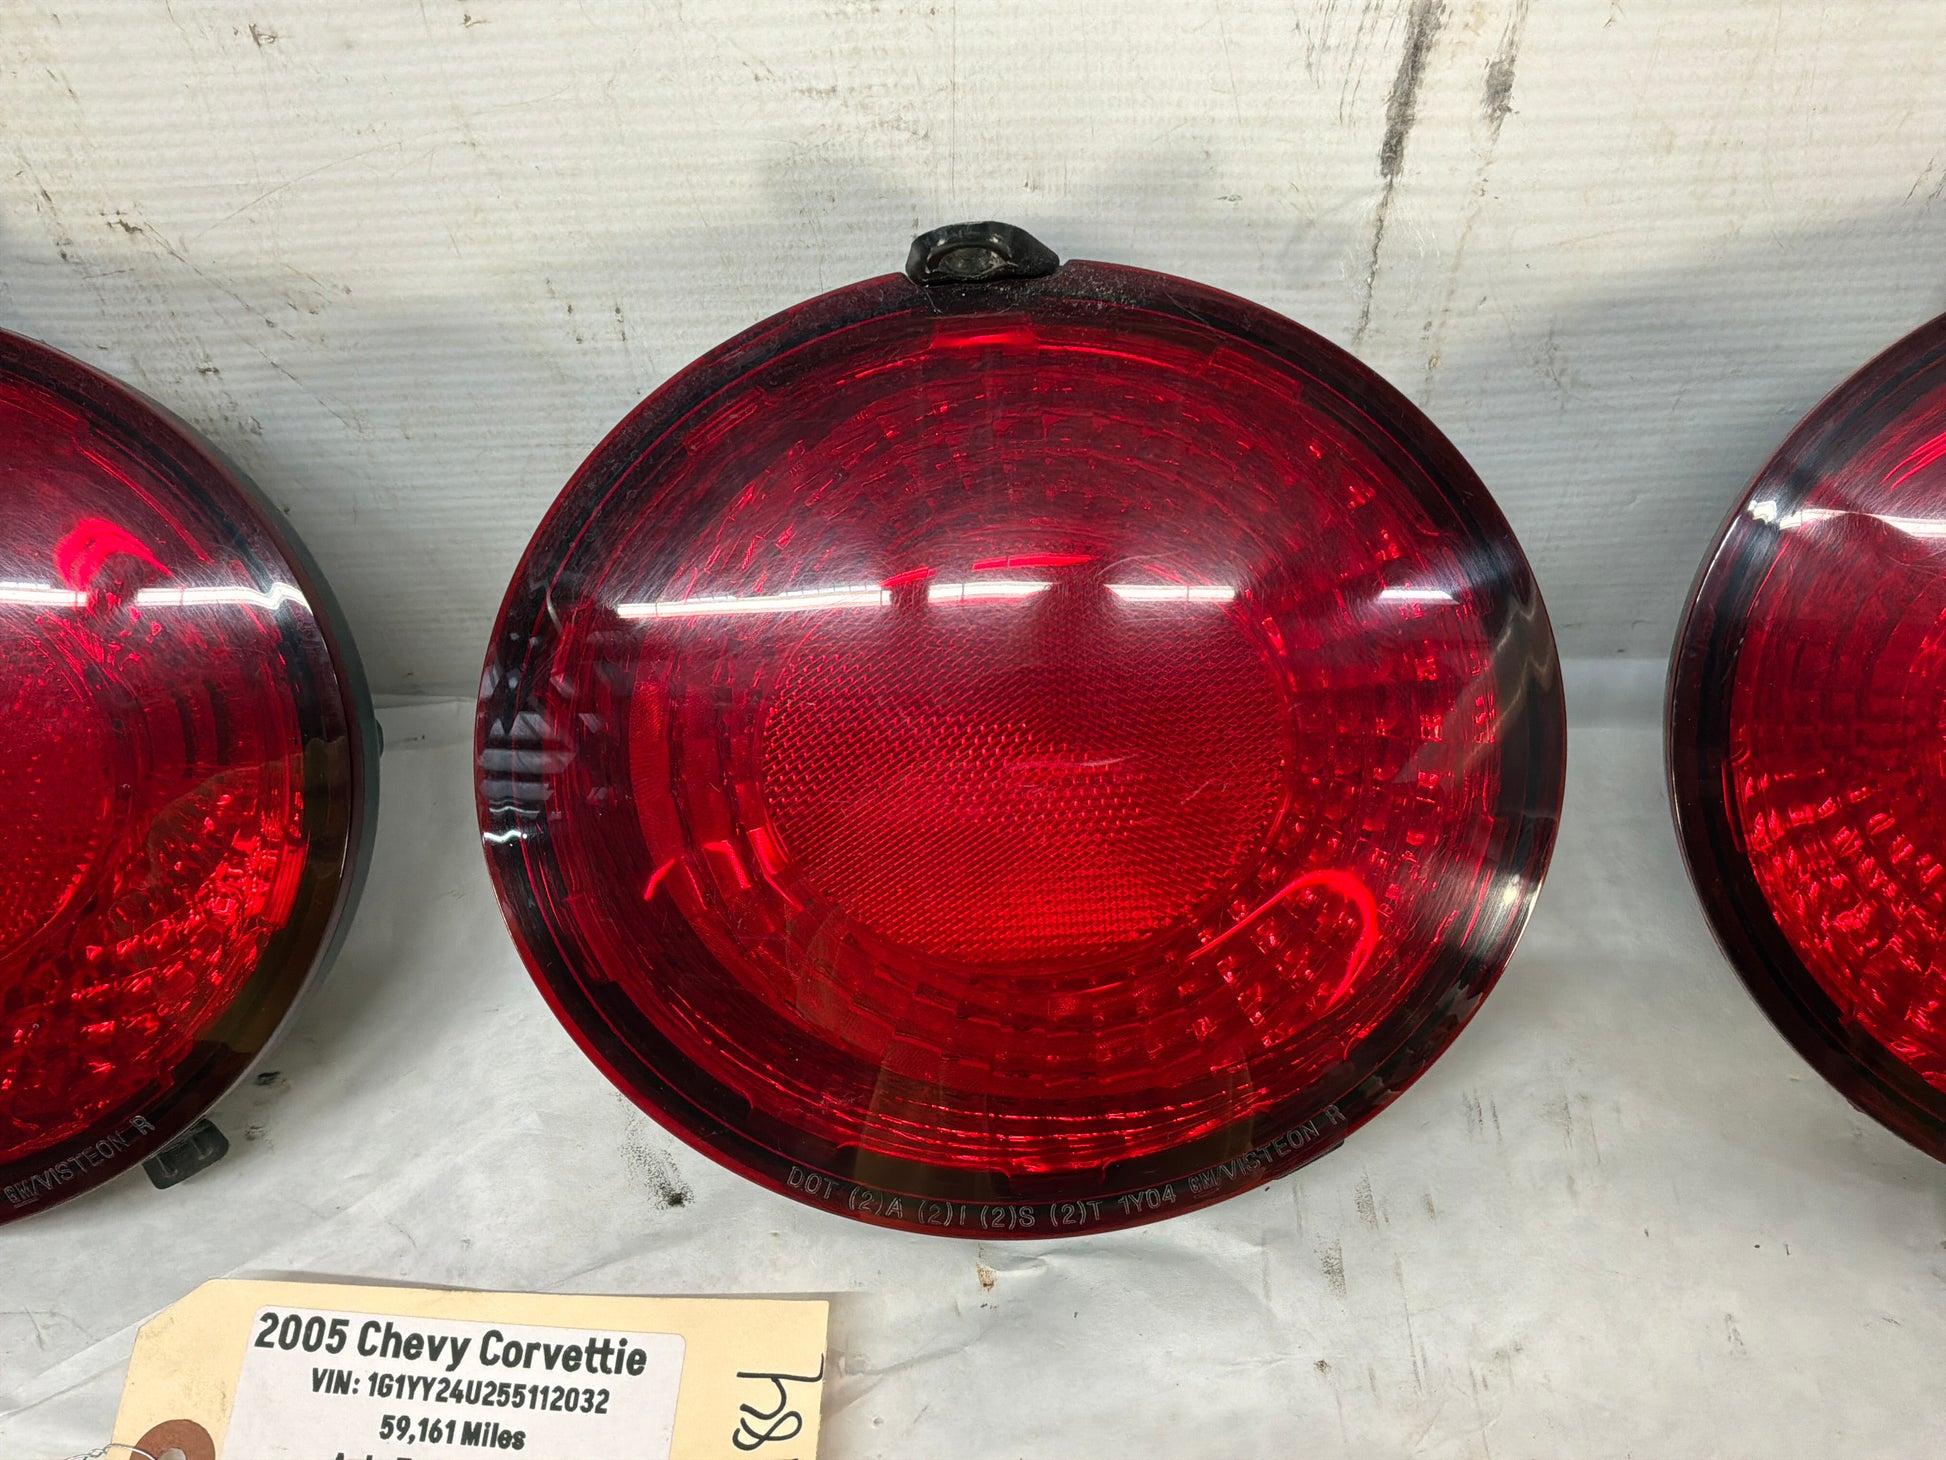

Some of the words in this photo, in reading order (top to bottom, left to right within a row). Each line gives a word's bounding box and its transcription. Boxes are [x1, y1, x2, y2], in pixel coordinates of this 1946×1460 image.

[129, 1115, 155, 1136] R
[786, 1166, 840, 1200] DOT
[848, 1186, 904, 1219] (2)A
[980, 1204, 1036, 1230] (2)S
[1049, 1200, 1103, 1227] (2)T
[1325, 1103, 1347, 1125] R
[254, 1311, 350, 1354] 2005
[357, 1320, 472, 1372] Chevy
[479, 1329, 648, 1377] Corvettie
[312, 1367, 361, 1395] VIN:
[367, 1371, 611, 1415] 1G1YY24U255112032
[379, 1414, 457, 1445] 59,161
[460, 1420, 527, 1450] Miles
